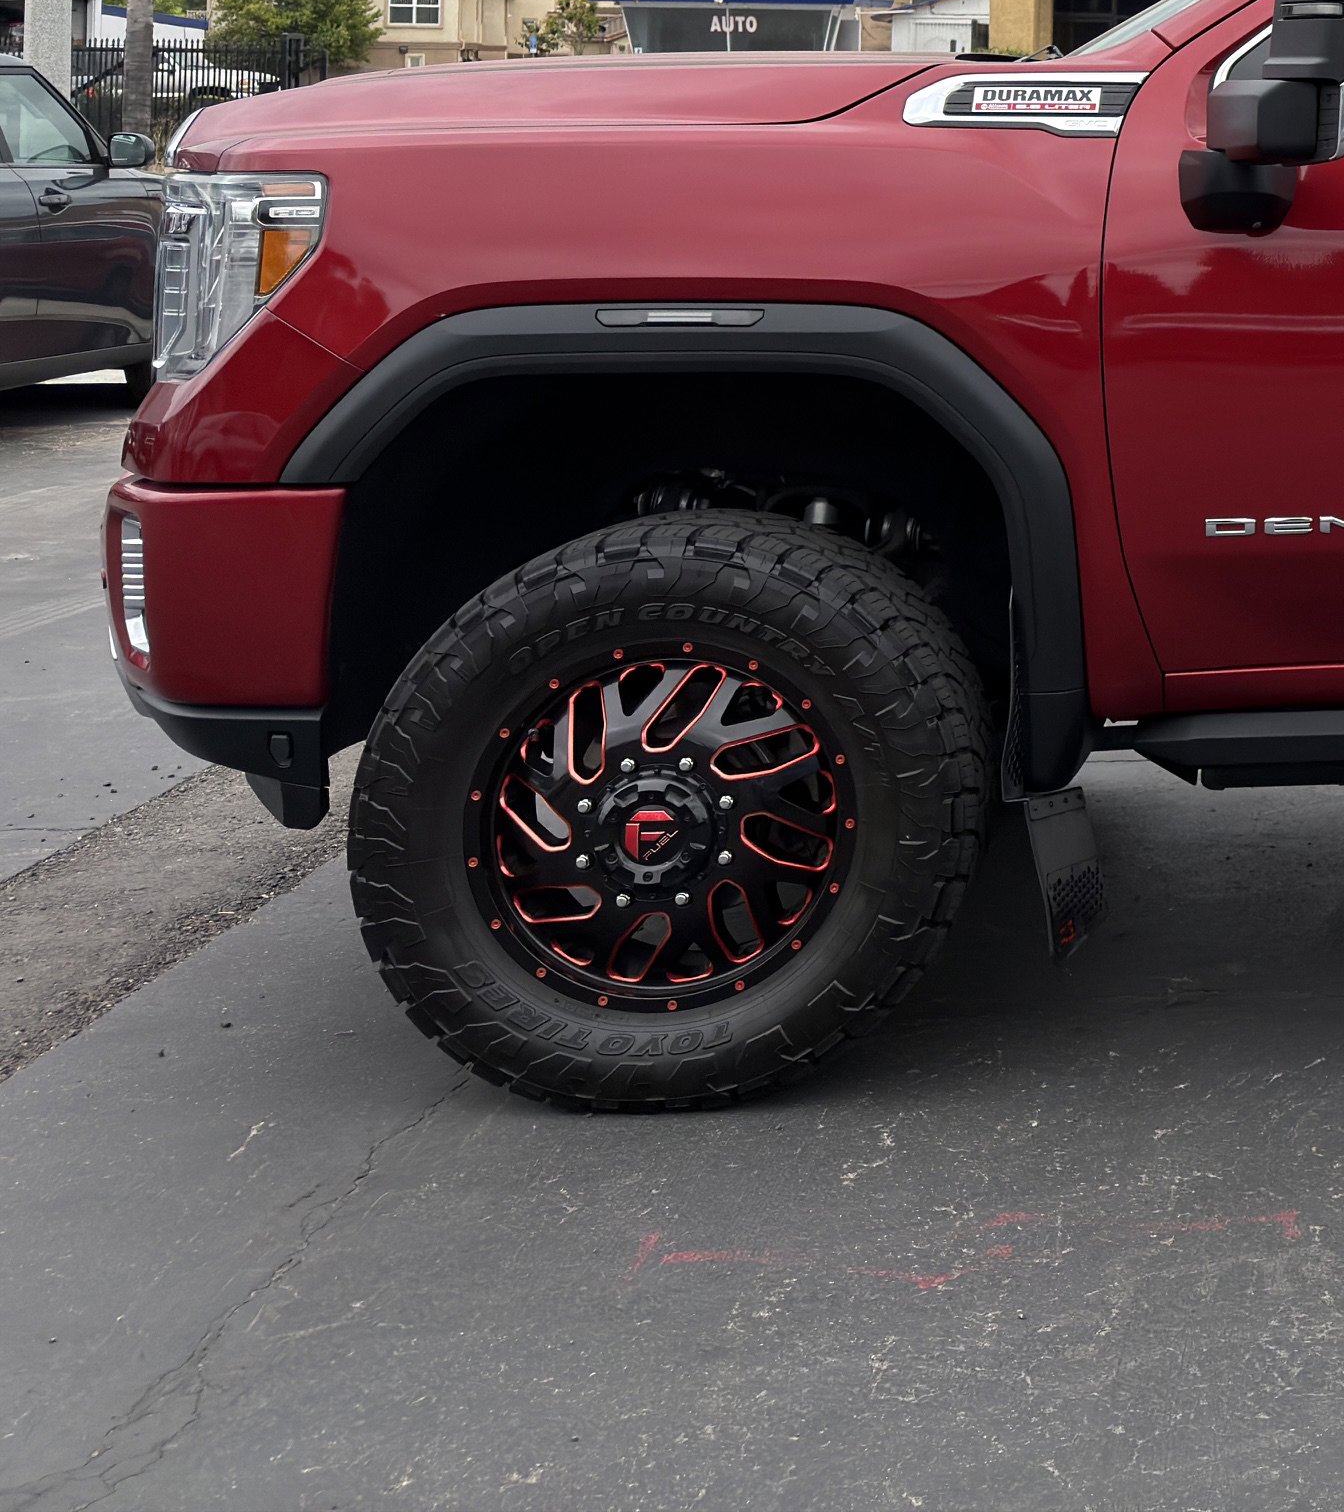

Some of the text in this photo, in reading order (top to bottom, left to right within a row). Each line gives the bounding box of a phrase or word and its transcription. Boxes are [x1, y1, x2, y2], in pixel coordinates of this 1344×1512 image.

[710, 15, 758, 33] AUTO
[982, 89, 1093, 102] DURAMAX
[507, 606, 625, 675] OPEN
[636, 600, 837, 677] COUNTRY
[642, 829, 679, 861] FUEL
[451, 960, 734, 1057] TOYO TIRES
